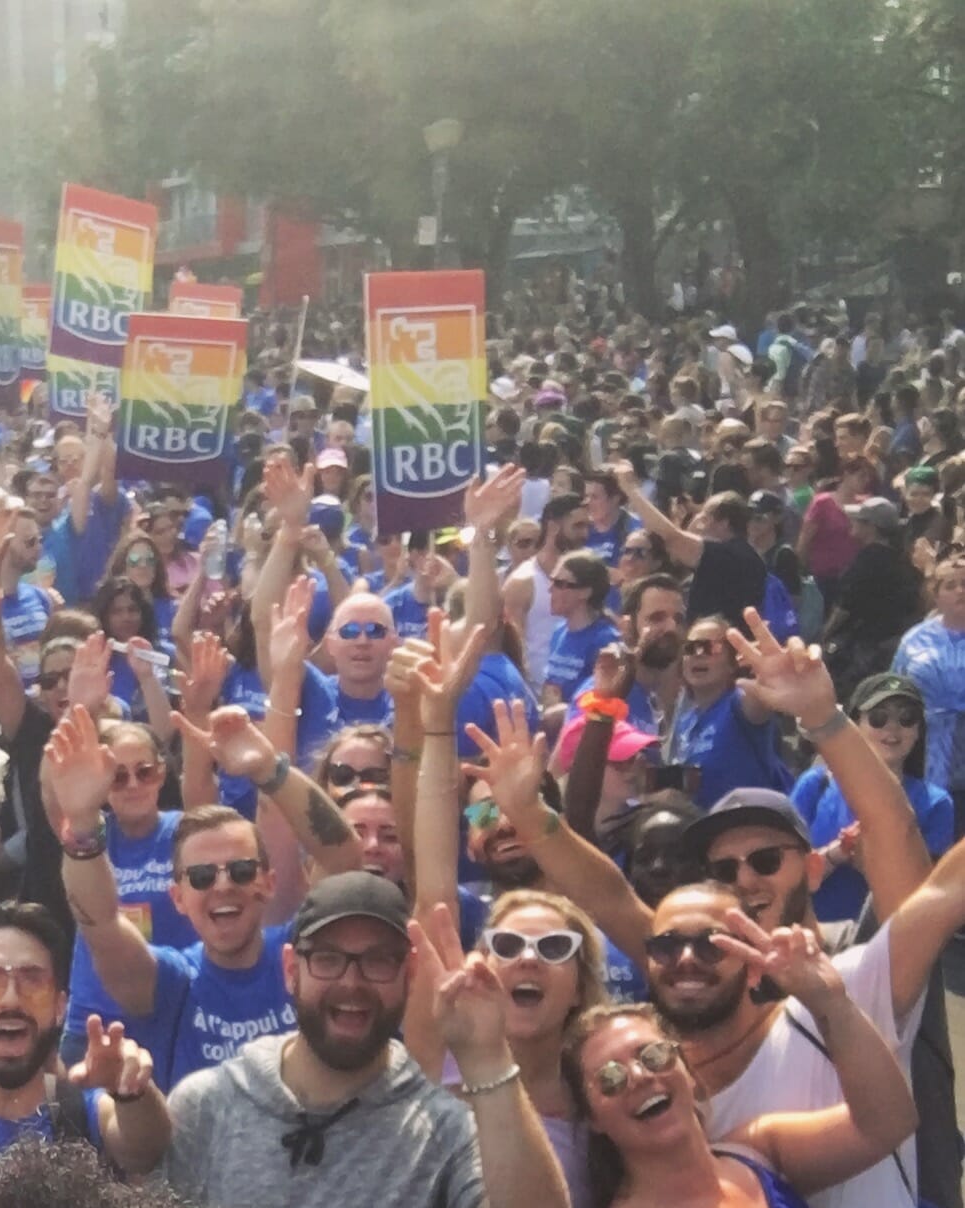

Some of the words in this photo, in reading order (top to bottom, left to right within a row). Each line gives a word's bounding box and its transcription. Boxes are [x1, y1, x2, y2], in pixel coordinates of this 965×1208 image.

[68, 300, 129, 337] RBC
[137, 424, 214, 453] RBC
[392, 440, 470, 483] RBC
